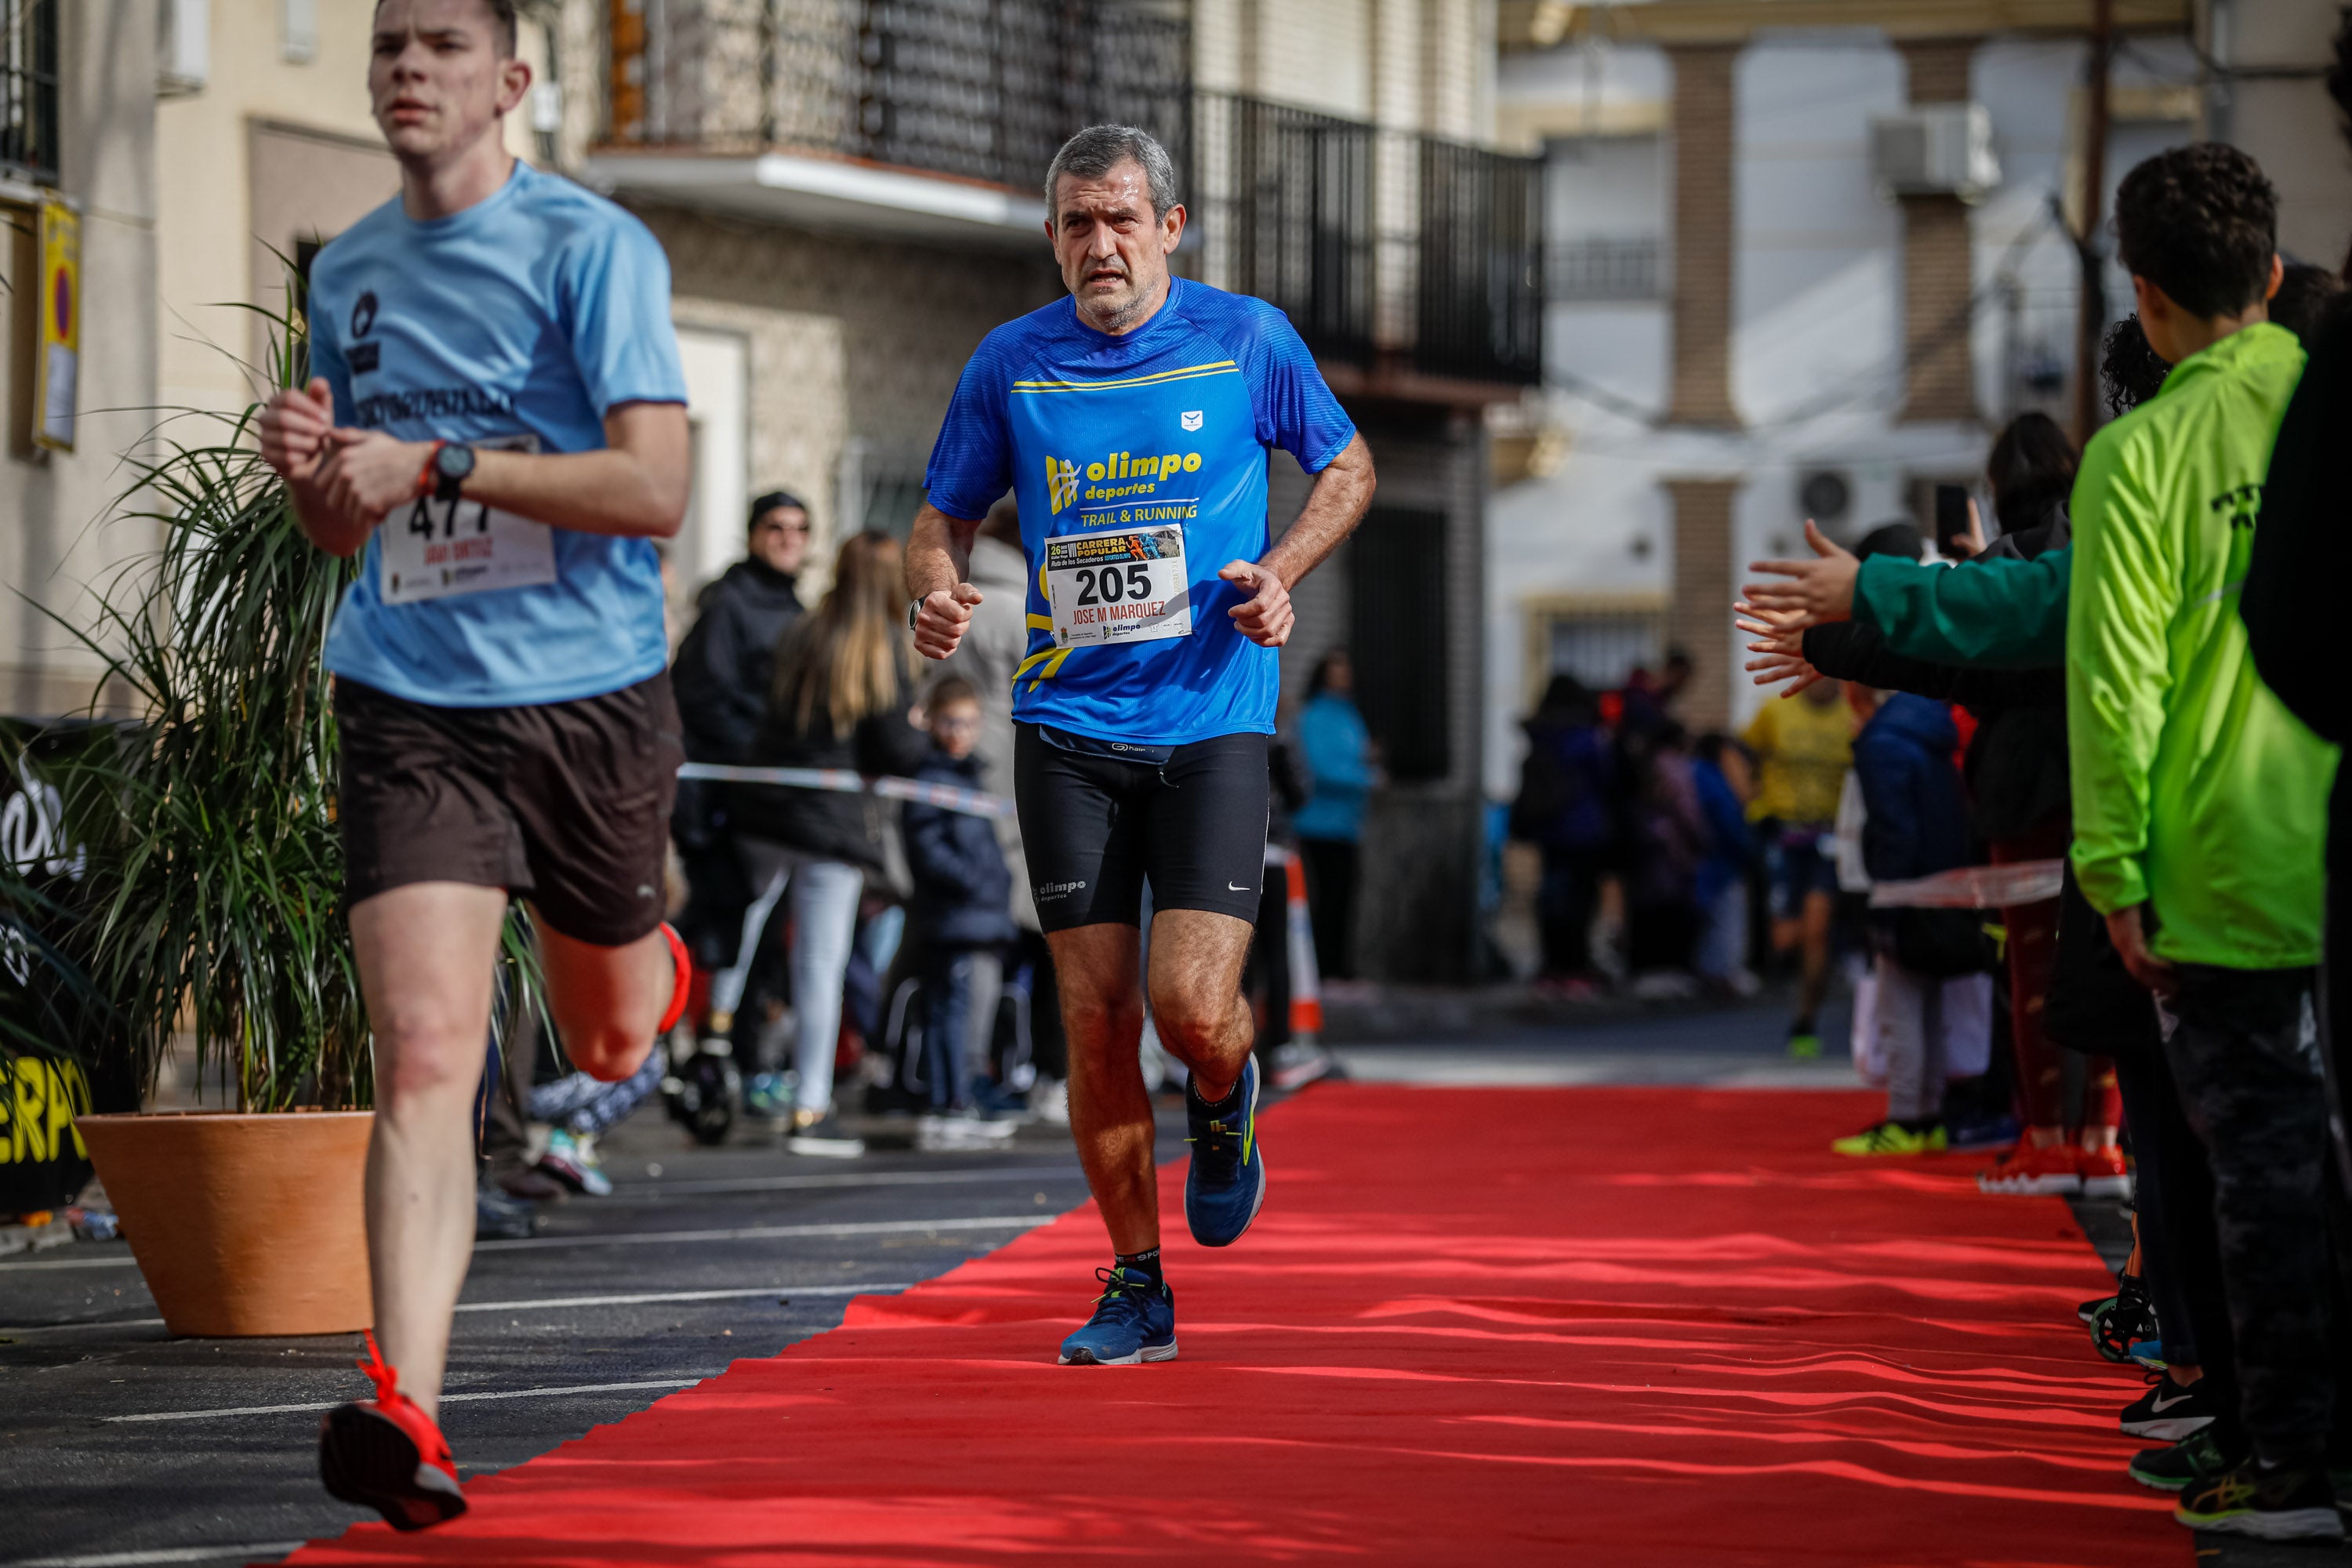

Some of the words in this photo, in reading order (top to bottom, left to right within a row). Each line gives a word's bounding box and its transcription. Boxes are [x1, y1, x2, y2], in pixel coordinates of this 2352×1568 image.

[1086, 451, 1202, 481] olimpo
[1085, 483, 1155, 502] deportes
[1081, 512, 1116, 527] TRAIL
[1120, 510, 1131, 522] &
[1135, 505, 1197, 521] RUNNING
[1051, 545, 1061, 555] 26
[1076, 537, 1126, 550] CARRERA
[1077, 546, 1127, 557] POPULAR
[1076, 556, 1104, 564] Secaderos
[1076, 563, 1152, 606] 205
[1073, 608, 1095, 625] JOSE
[1097, 607, 1107, 622] M
[1109, 601, 1166, 620] MARQUEZ
[1040, 880, 1087, 894] olimpo
